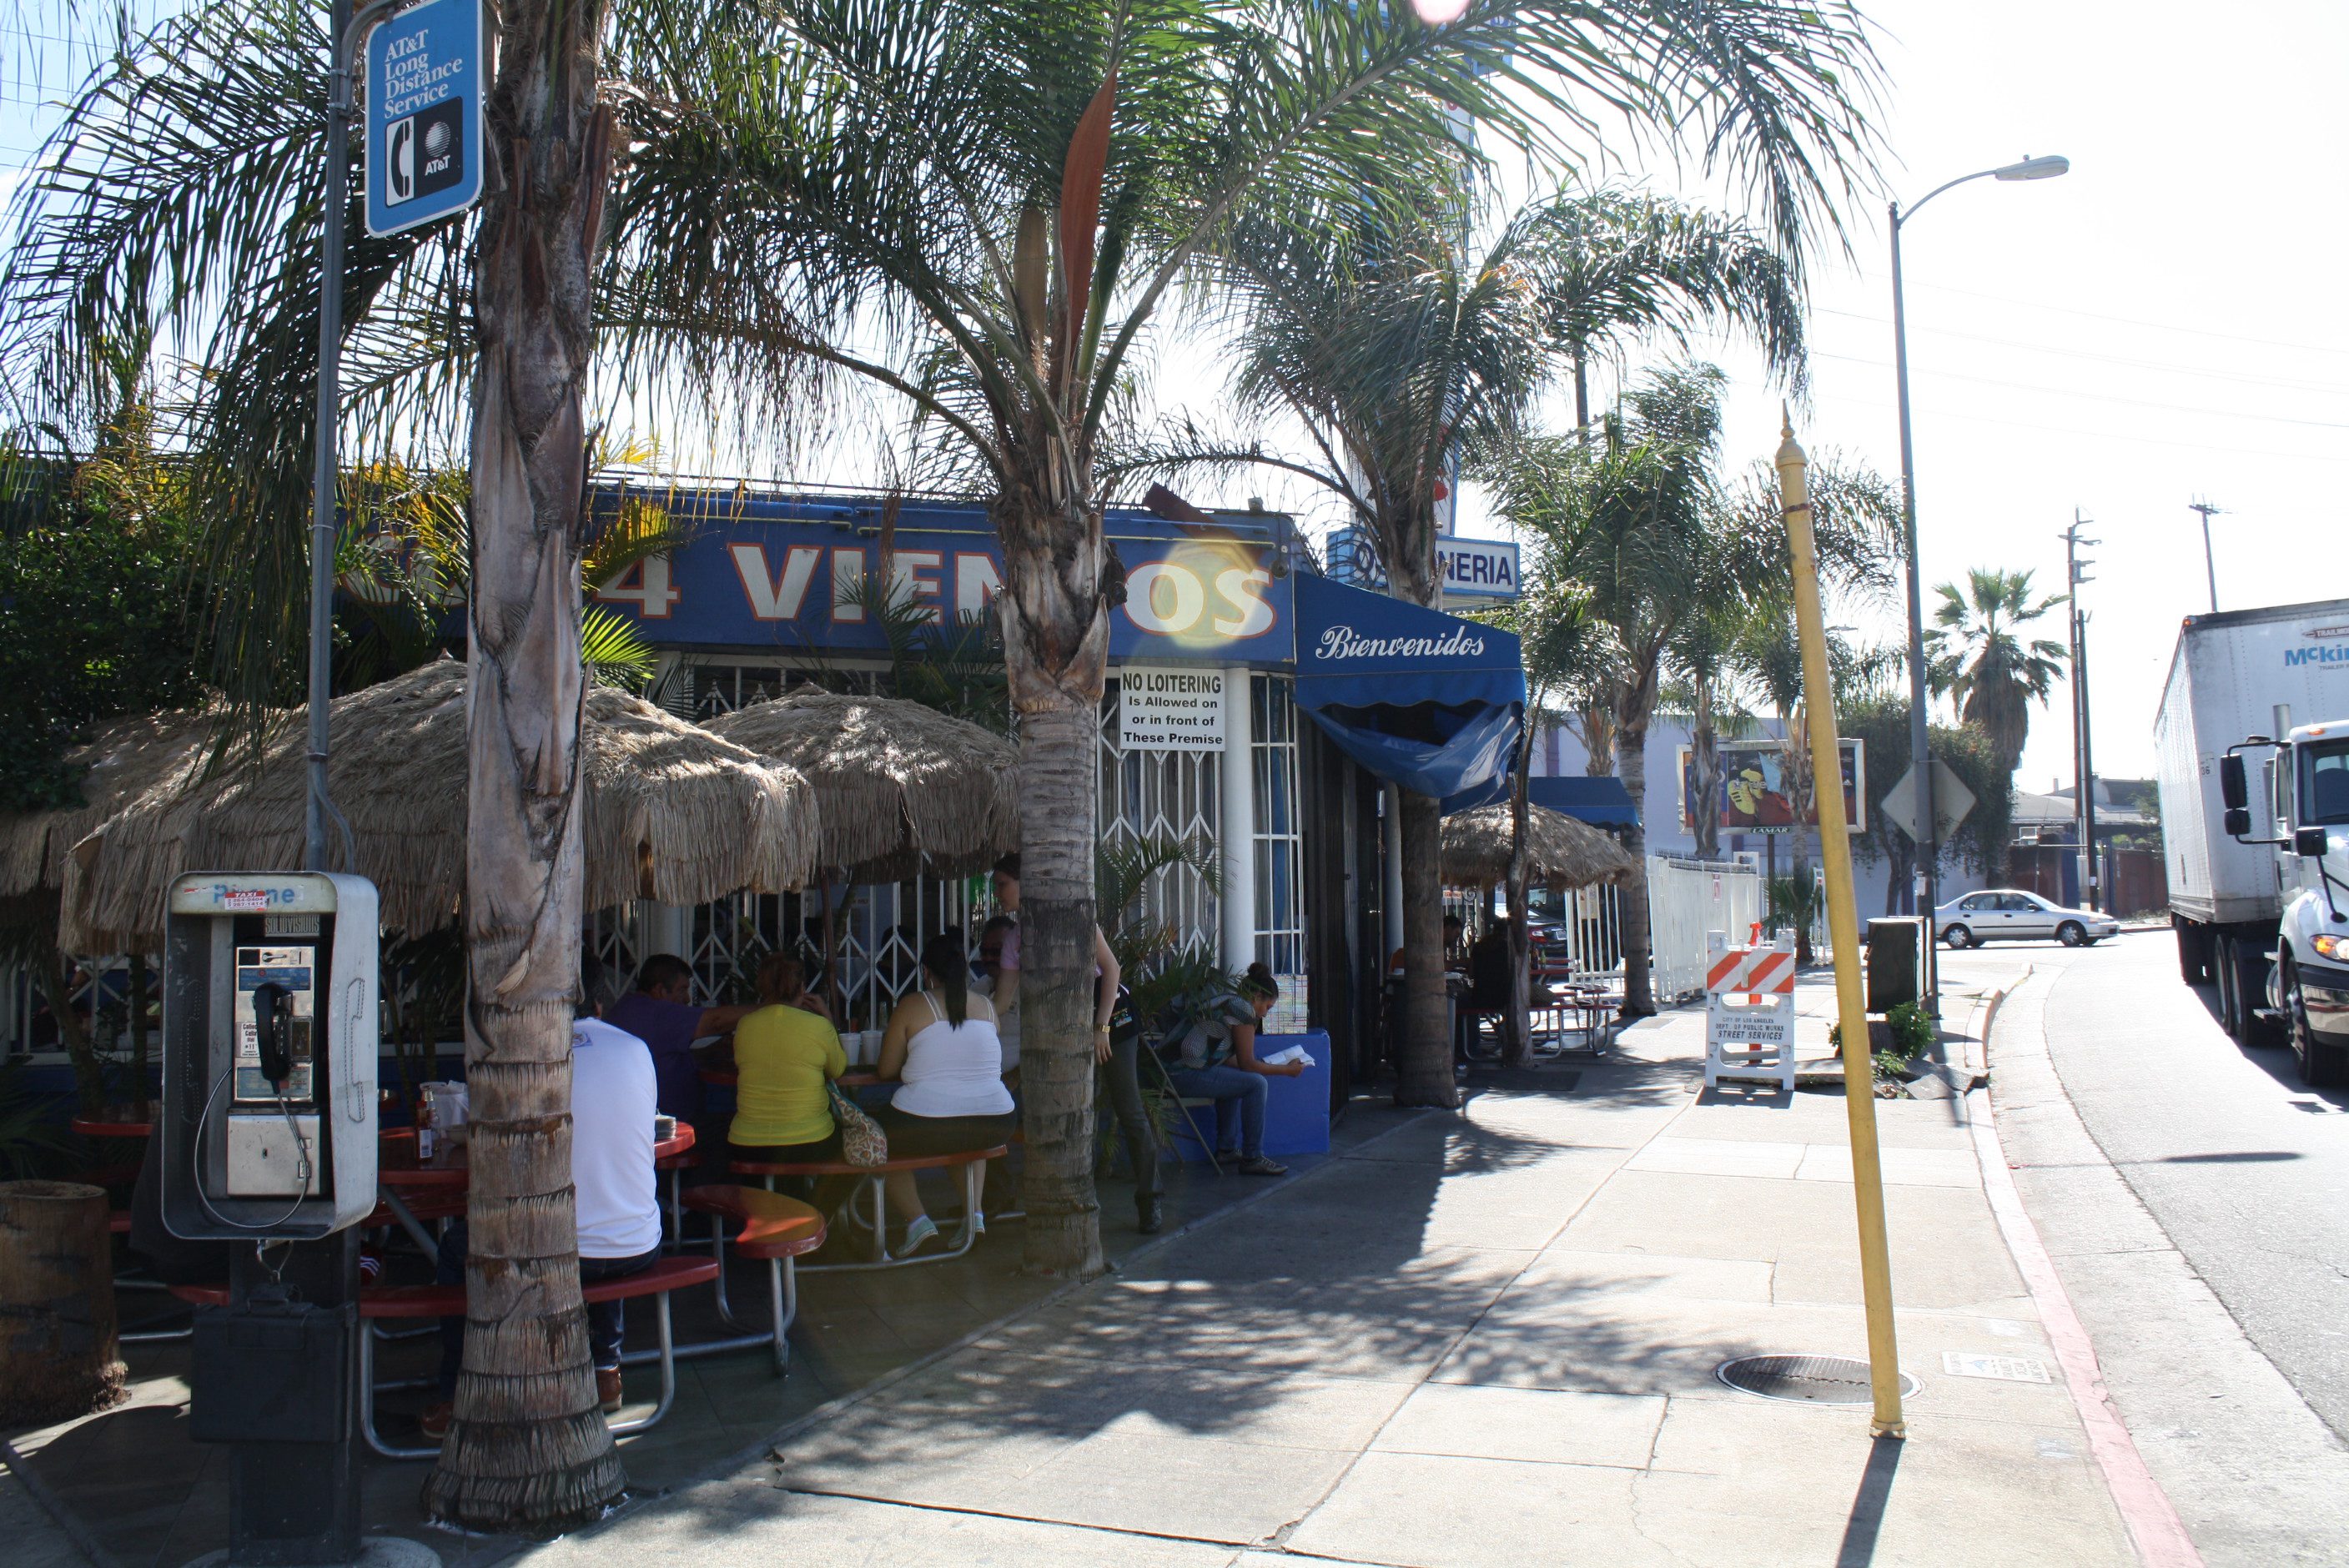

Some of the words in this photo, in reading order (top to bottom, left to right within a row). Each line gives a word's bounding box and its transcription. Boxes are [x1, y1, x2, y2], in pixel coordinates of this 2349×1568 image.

[385, 28, 429, 63] AT&T
[385, 53, 429, 82] Long
[385, 58, 463, 100] Distance
[384, 83, 449, 119] Service
[425, 155, 451, 177] AT&T
[1354, 541, 1513, 586] ONERIA
[591, 547, 682, 619] 4
[726, 541, 1278, 641] VIENOS
[1315, 625, 1485, 660] Bienvenidos
[1123, 672, 1143, 691] NO
[1147, 673, 1221, 694] LOITERING
[1129, 696, 1140, 706] Is
[1145, 696, 1198, 708] Allowed
[1202, 701, 1218, 709] on
[1132, 716, 1145, 724] or
[1149, 715, 1162, 725] in
[1165, 715, 1198, 726] front
[1201, 716, 1215, 726] of
[1124, 731, 1164, 743] These
[1169, 733, 1223, 745] Premise
[214, 884, 295, 904] Pne
[1718, 1030, 1745, 1039] STREET
[1748, 1031, 1783, 1040] SERVICES
